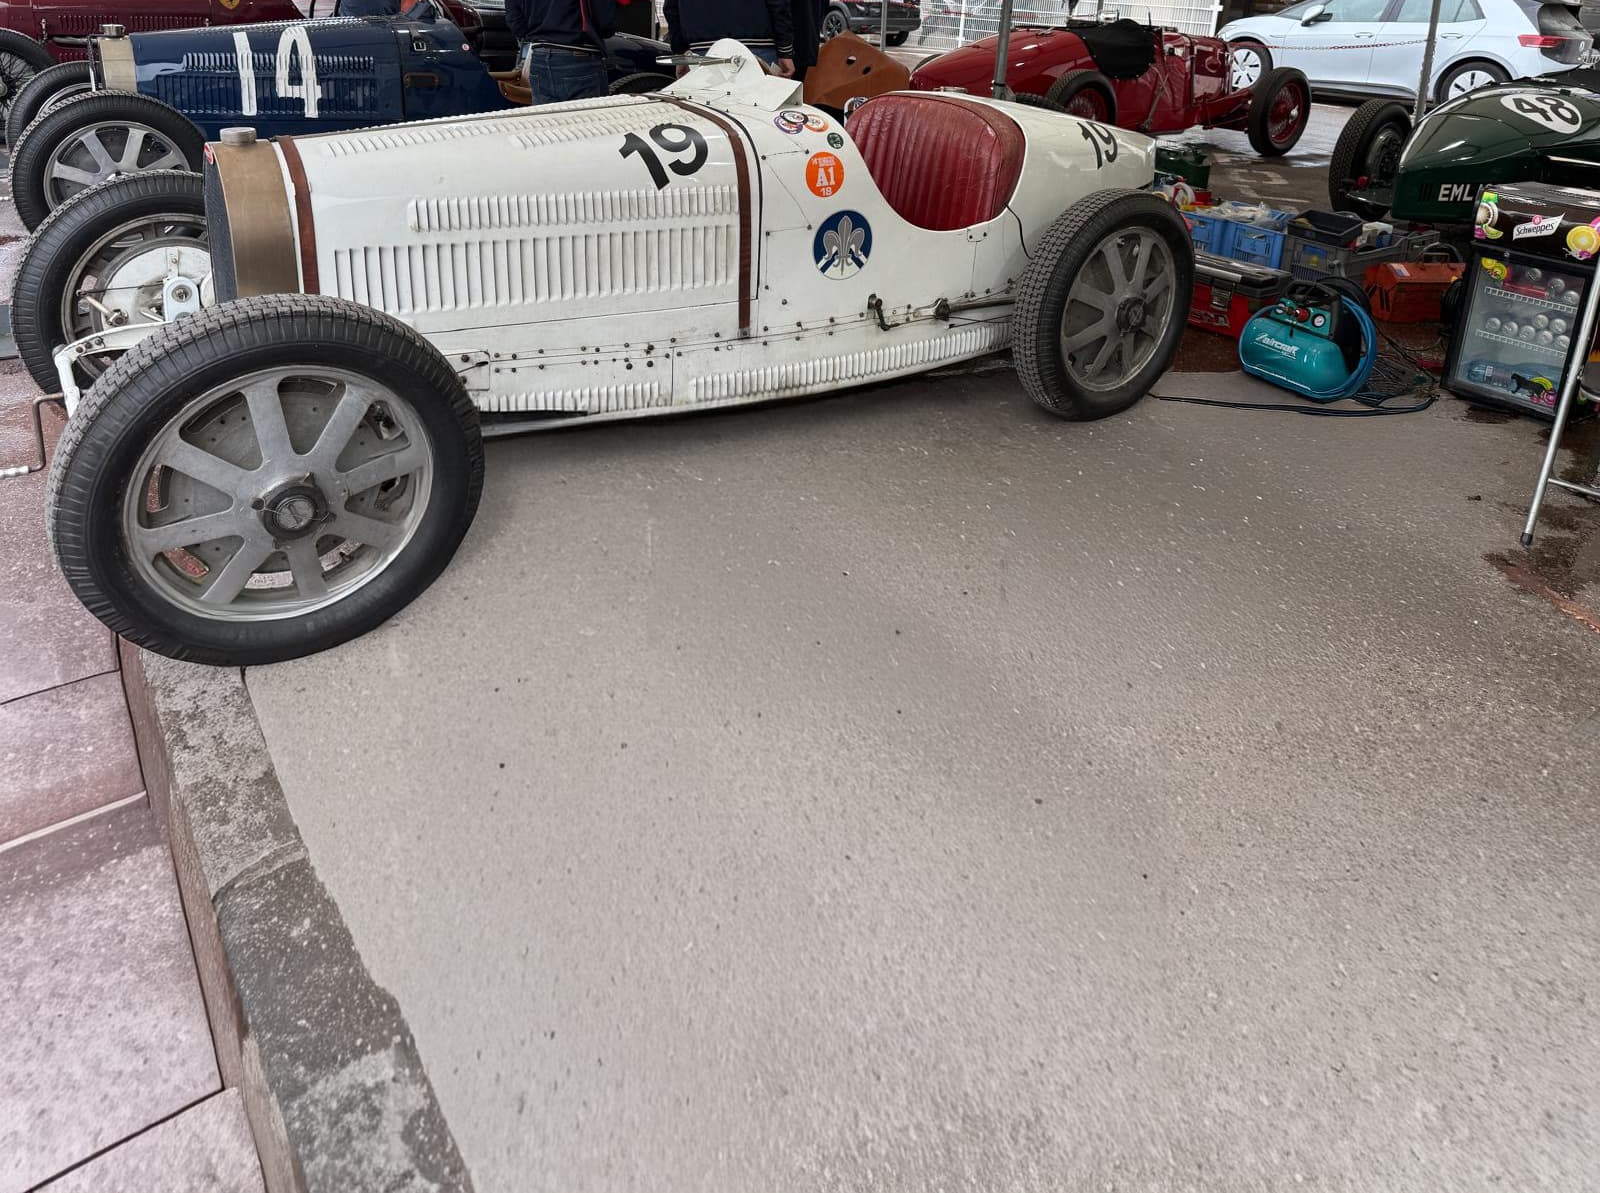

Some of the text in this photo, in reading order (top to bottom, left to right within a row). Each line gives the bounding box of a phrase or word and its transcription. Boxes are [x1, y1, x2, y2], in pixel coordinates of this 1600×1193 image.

[232, 26, 322, 118] 14
[1512, 96, 1580, 126] 48
[618, 122, 709, 191] 19
[1076, 120, 1118, 170] 19
[816, 166, 836, 187] A1
[820, 187, 833, 197] 18
[1437, 184, 1474, 202] EML
[1515, 221, 1555, 237] Schweppes
